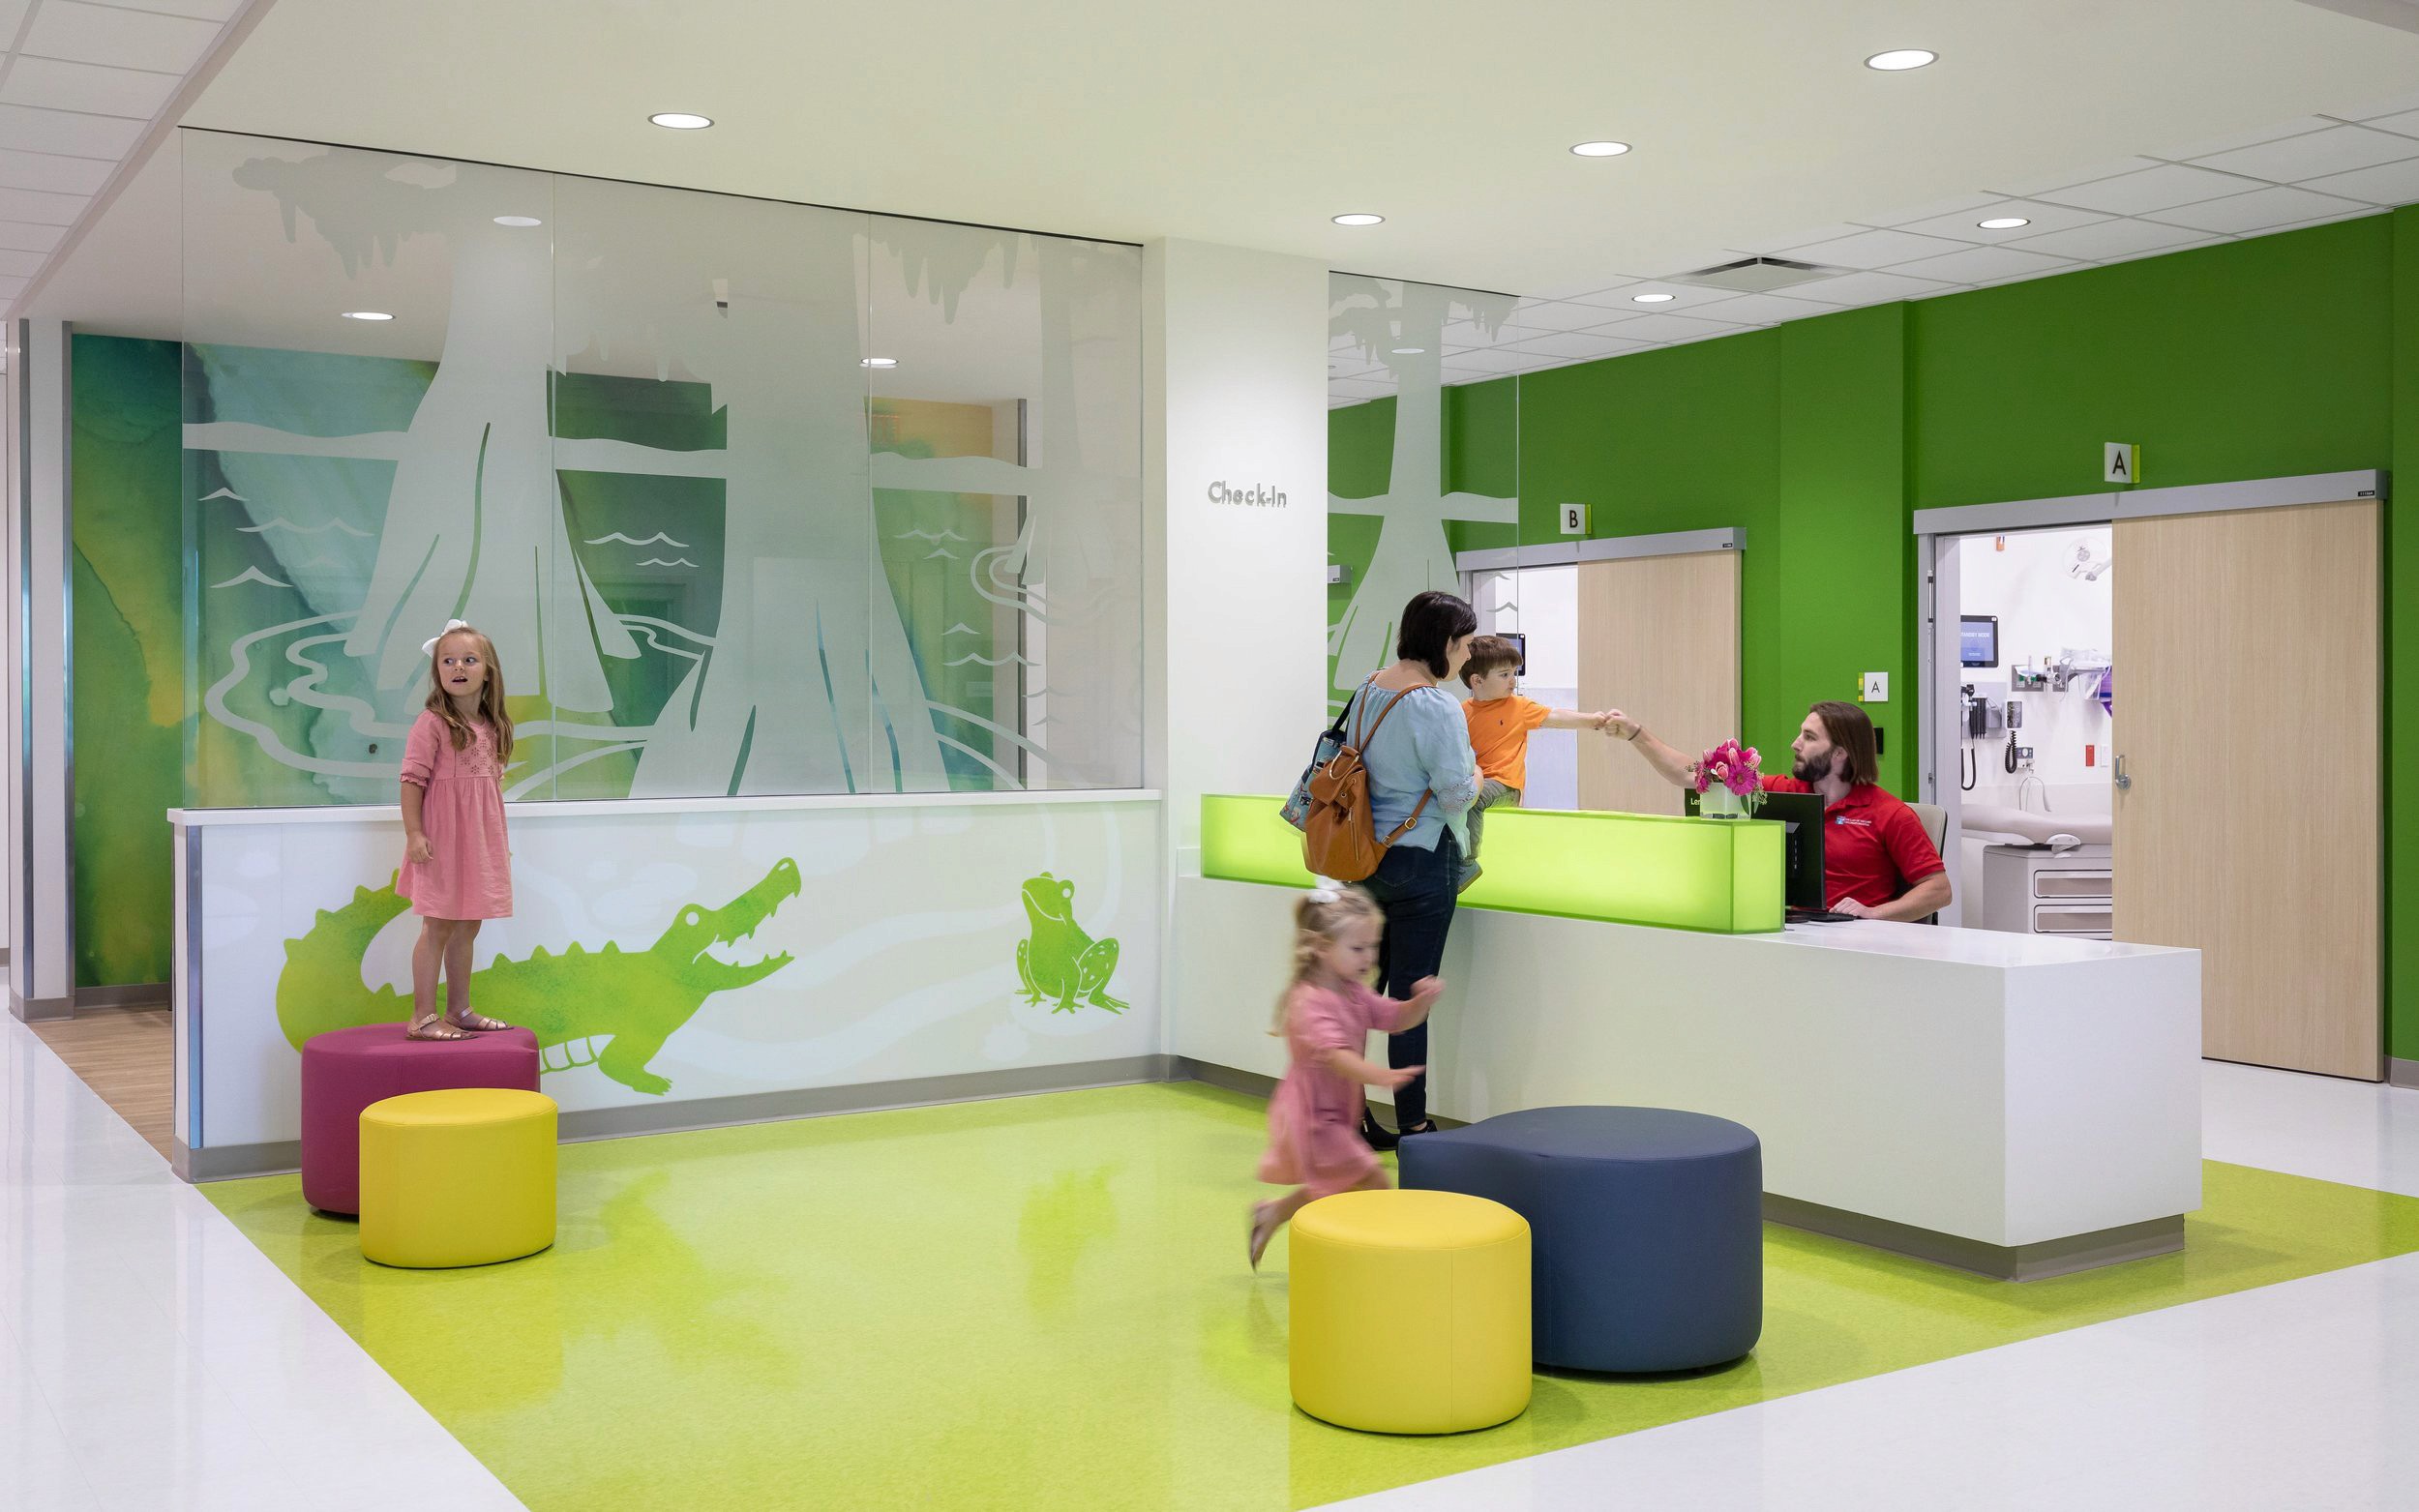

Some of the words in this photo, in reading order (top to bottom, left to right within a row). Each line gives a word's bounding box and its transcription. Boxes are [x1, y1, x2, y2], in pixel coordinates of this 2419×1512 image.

[2112, 450, 2127, 475] A
[1208, 480, 1287, 508] Check-In
[1569, 509, 1578, 528] B
[1871, 680, 1881, 694] A
